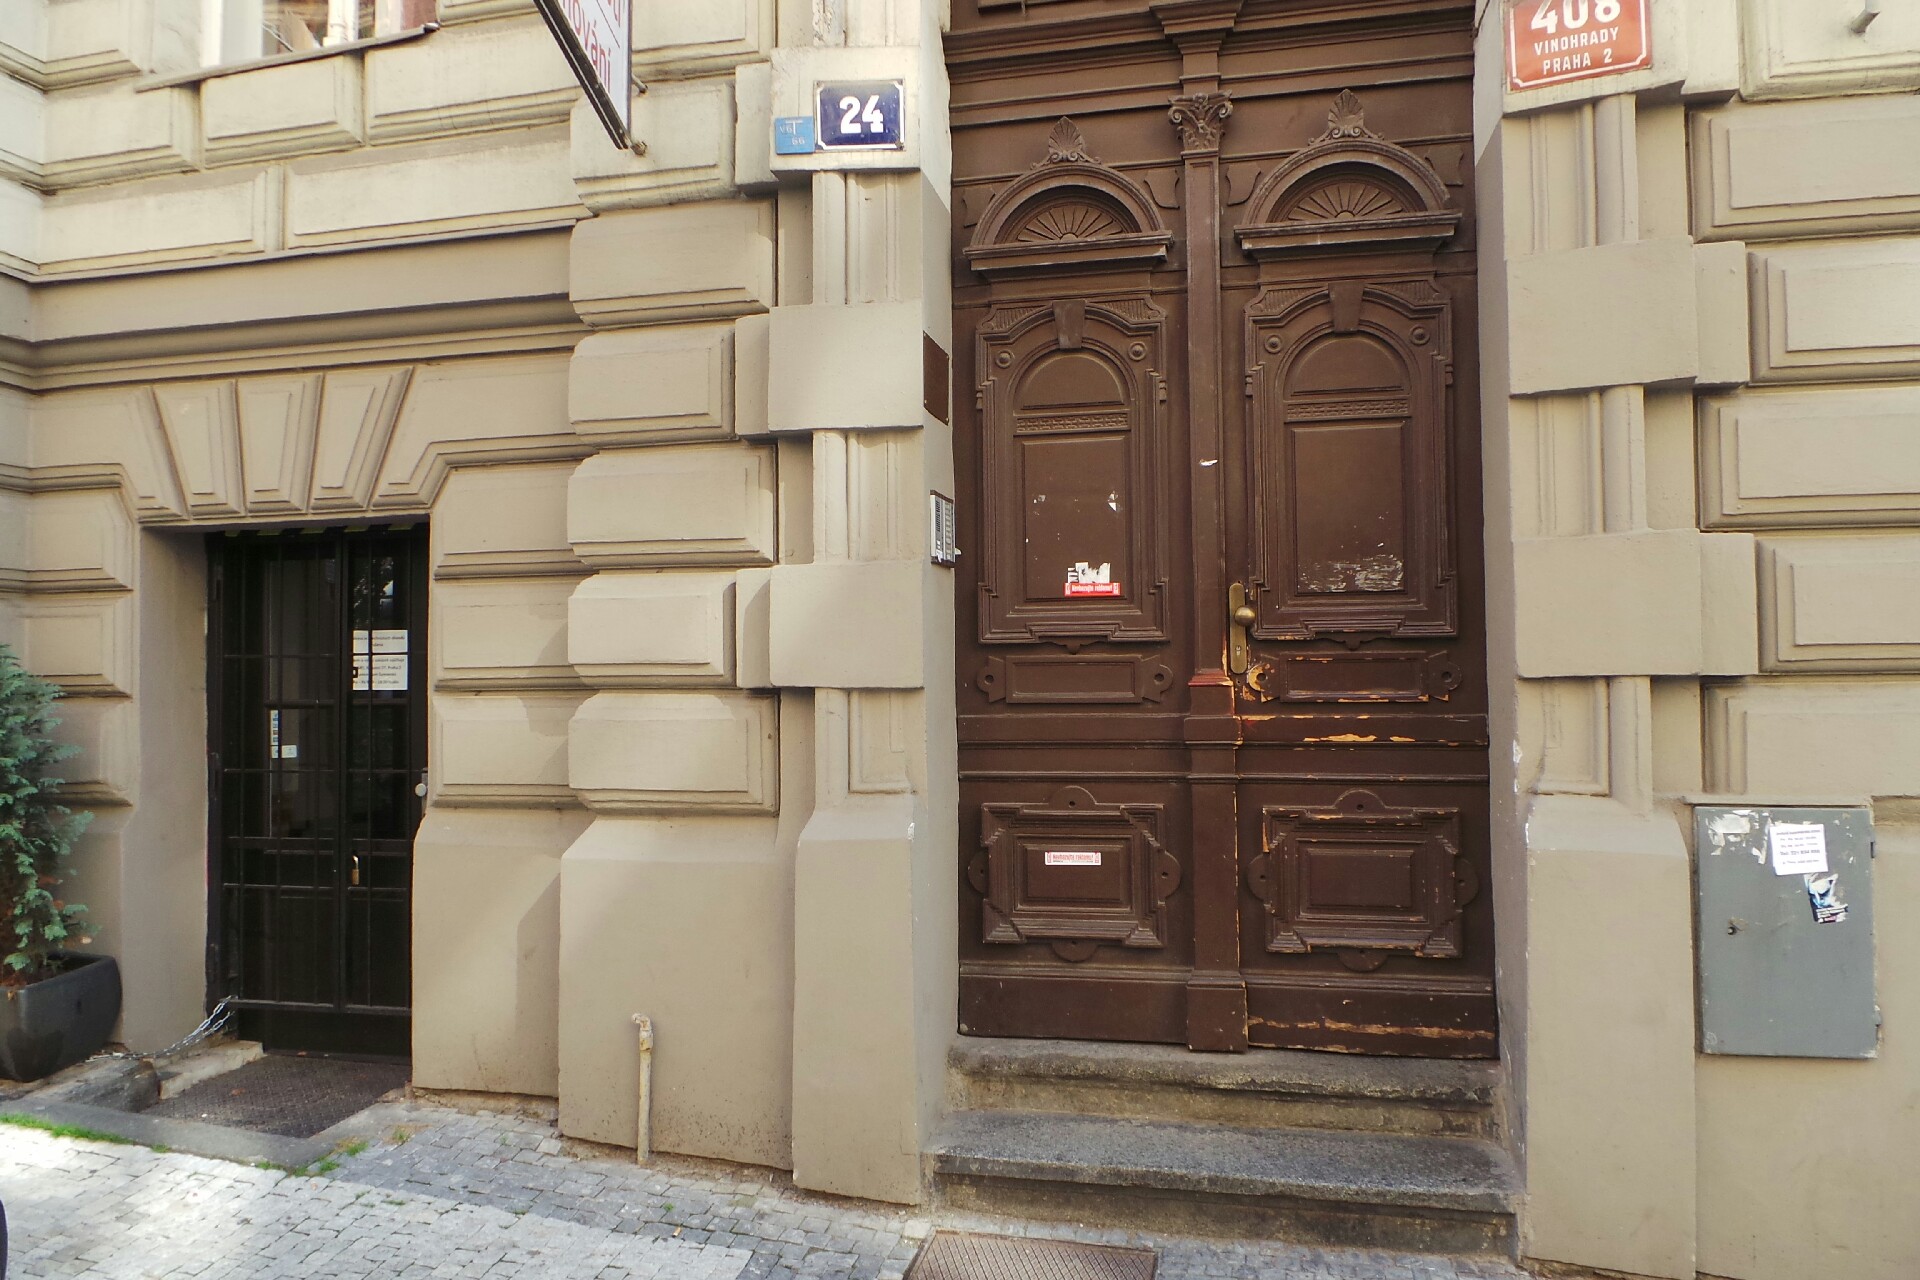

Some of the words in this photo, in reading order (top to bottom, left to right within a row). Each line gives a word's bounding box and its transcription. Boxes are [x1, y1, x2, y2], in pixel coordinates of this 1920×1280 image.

[1531, 0, 1621, 34] 408
[1534, 27, 1619, 56] VINOHRADY
[1543, 52, 1592, 75] PRAHA
[1603, 48, 1613, 64] 2
[839, 94, 884, 134] 24
